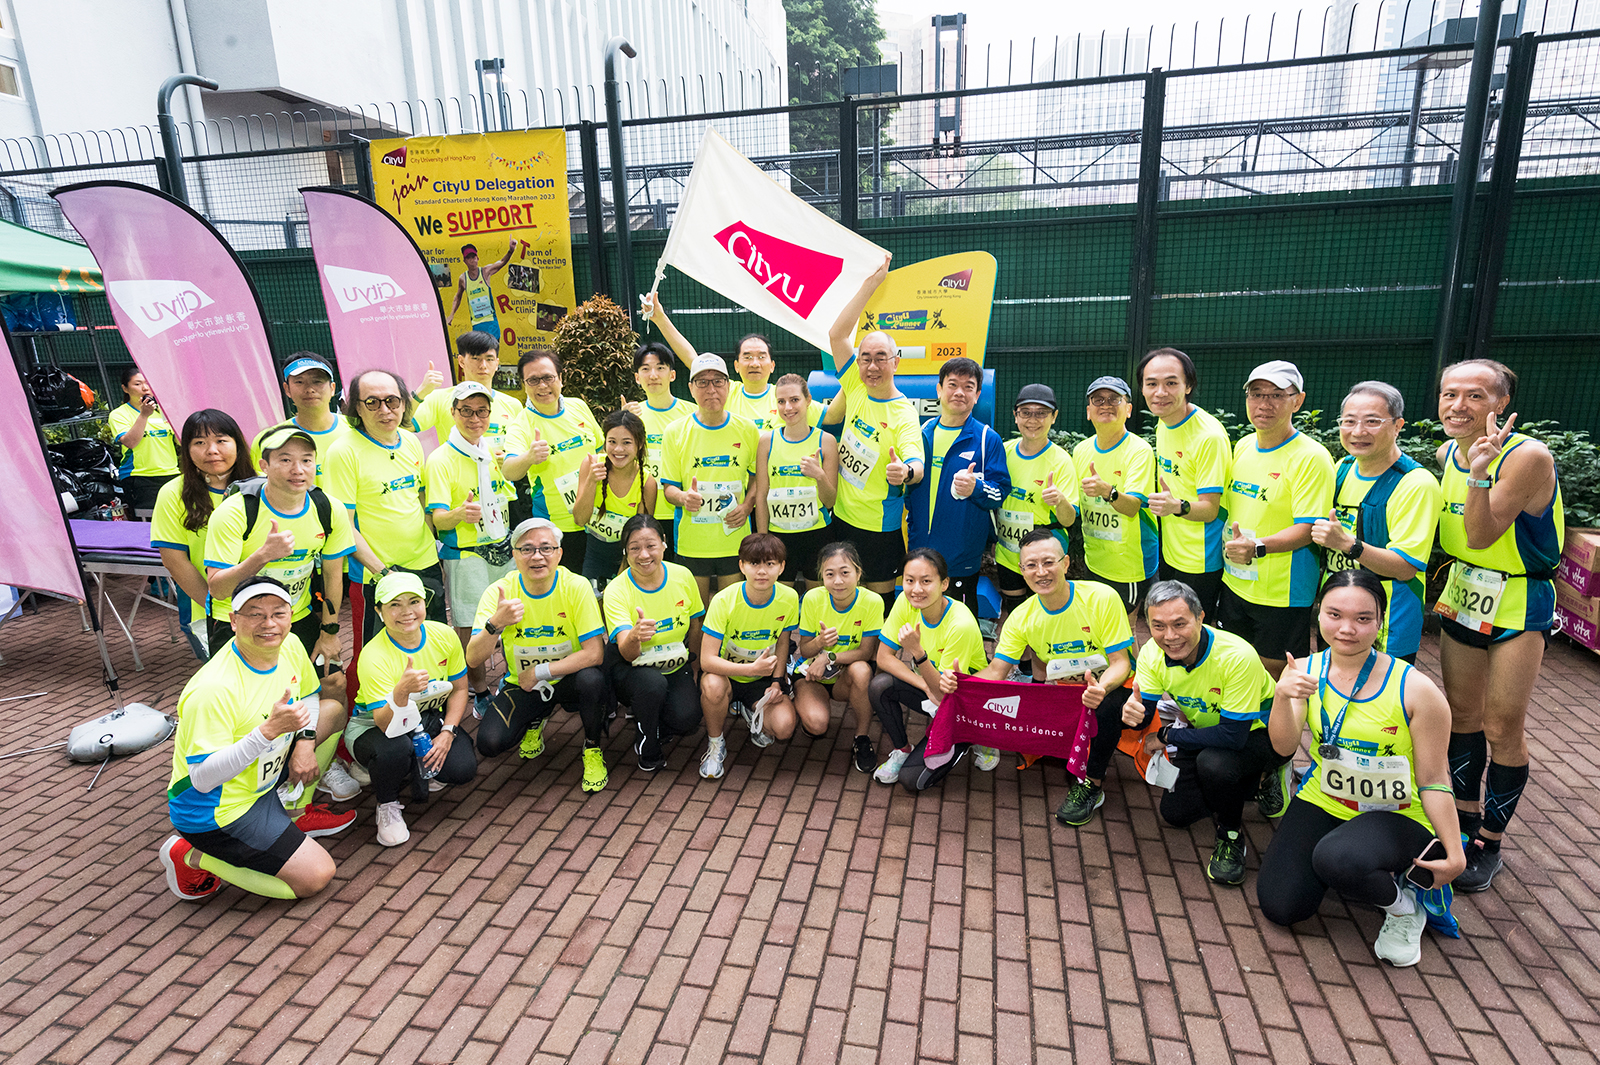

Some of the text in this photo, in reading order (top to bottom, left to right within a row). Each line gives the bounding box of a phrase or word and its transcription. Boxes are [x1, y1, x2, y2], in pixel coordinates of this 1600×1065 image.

[383, 156, 404, 166] CityU
[392, 172, 429, 215] join
[432, 176, 555, 195] CityU Delegation
[413, 203, 534, 236] We SUPPORT
[532, 257, 566, 266] Cheering
[727, 231, 805, 303] CityU
[941, 278, 966, 289] CityU
[885, 311, 910, 324] CityU
[936, 348, 962, 356] 2023
[839, 444, 869, 477] P2367
[772, 502, 814, 519] K4731
[1572, 567, 1585, 587] vita
[1573, 619, 1591, 640] vita
[987, 702, 1014, 715] CityU
[956, 714, 1064, 737] Student Residence
[1326, 769, 1407, 800] G1018
